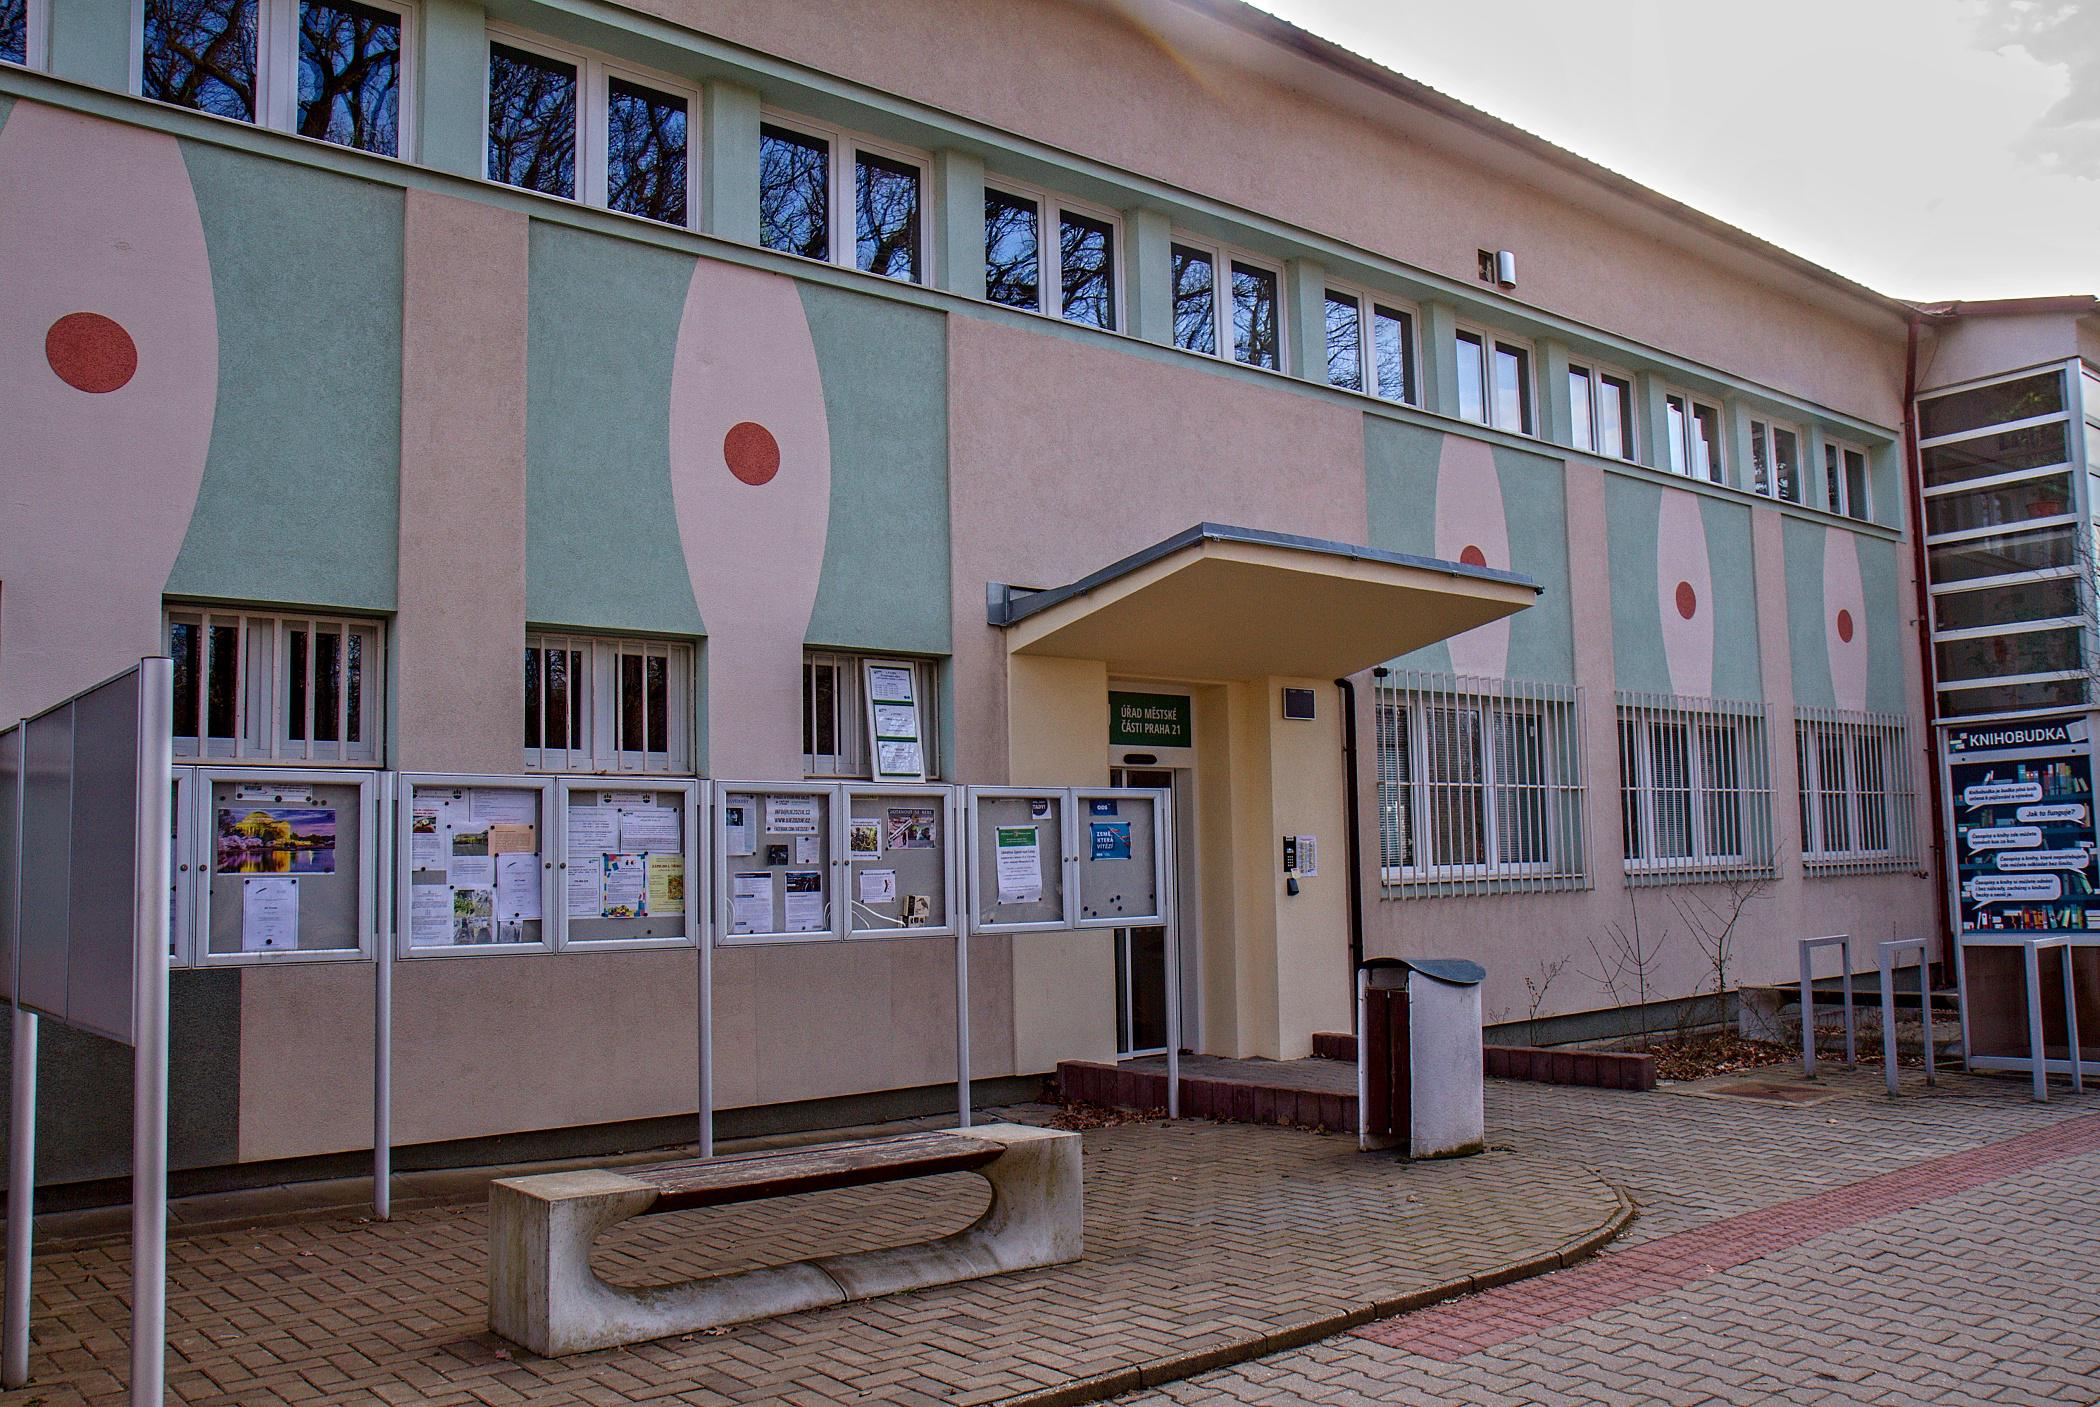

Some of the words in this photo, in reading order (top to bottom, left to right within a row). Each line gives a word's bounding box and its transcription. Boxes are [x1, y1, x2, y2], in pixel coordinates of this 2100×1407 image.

[1121, 704, 1142, 718] ÚŘAD
[1144, 706, 1176, 720] MĚSTSKÉ
[1122, 720, 1142, 733] ČÁSTI
[1144, 723, 1170, 734] PRAHA
[1172, 724, 1180, 735] 21
[1970, 728, 2066, 746] KNIHOBUDKA
